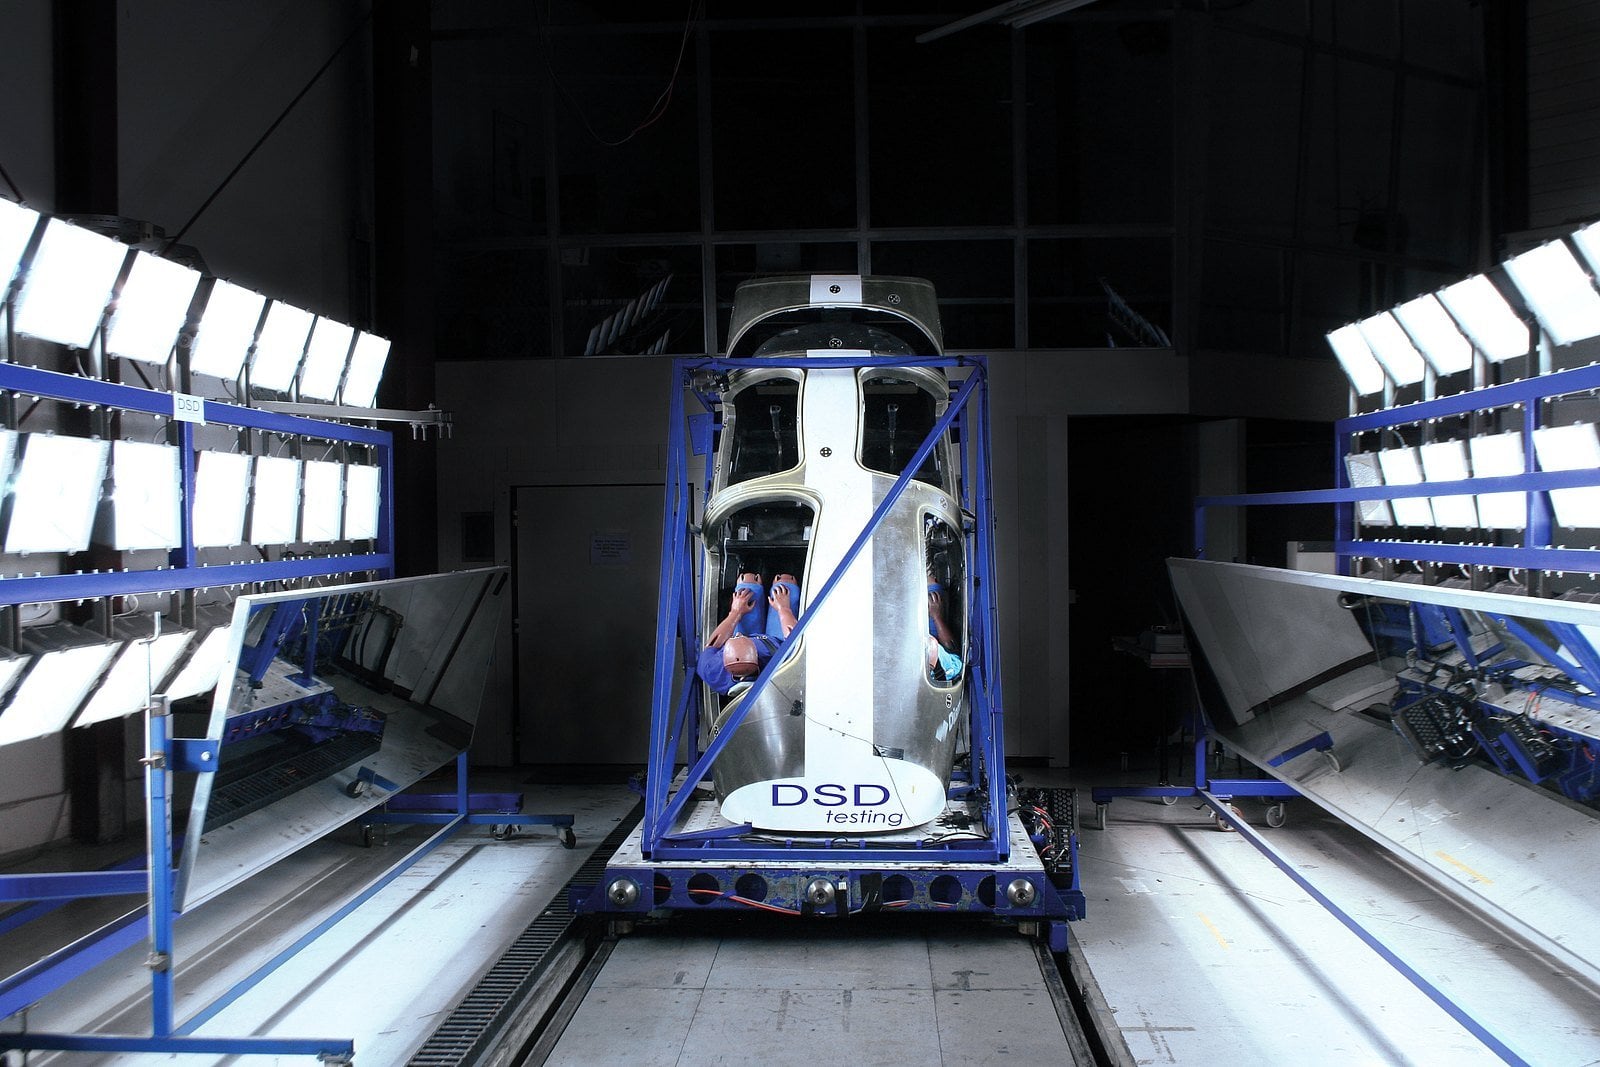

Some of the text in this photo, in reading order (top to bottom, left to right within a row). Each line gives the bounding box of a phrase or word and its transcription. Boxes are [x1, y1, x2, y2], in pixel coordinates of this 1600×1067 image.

[178, 398, 200, 412] DSD
[771, 784, 890, 807] DSD
[826, 809, 903, 827] testing
